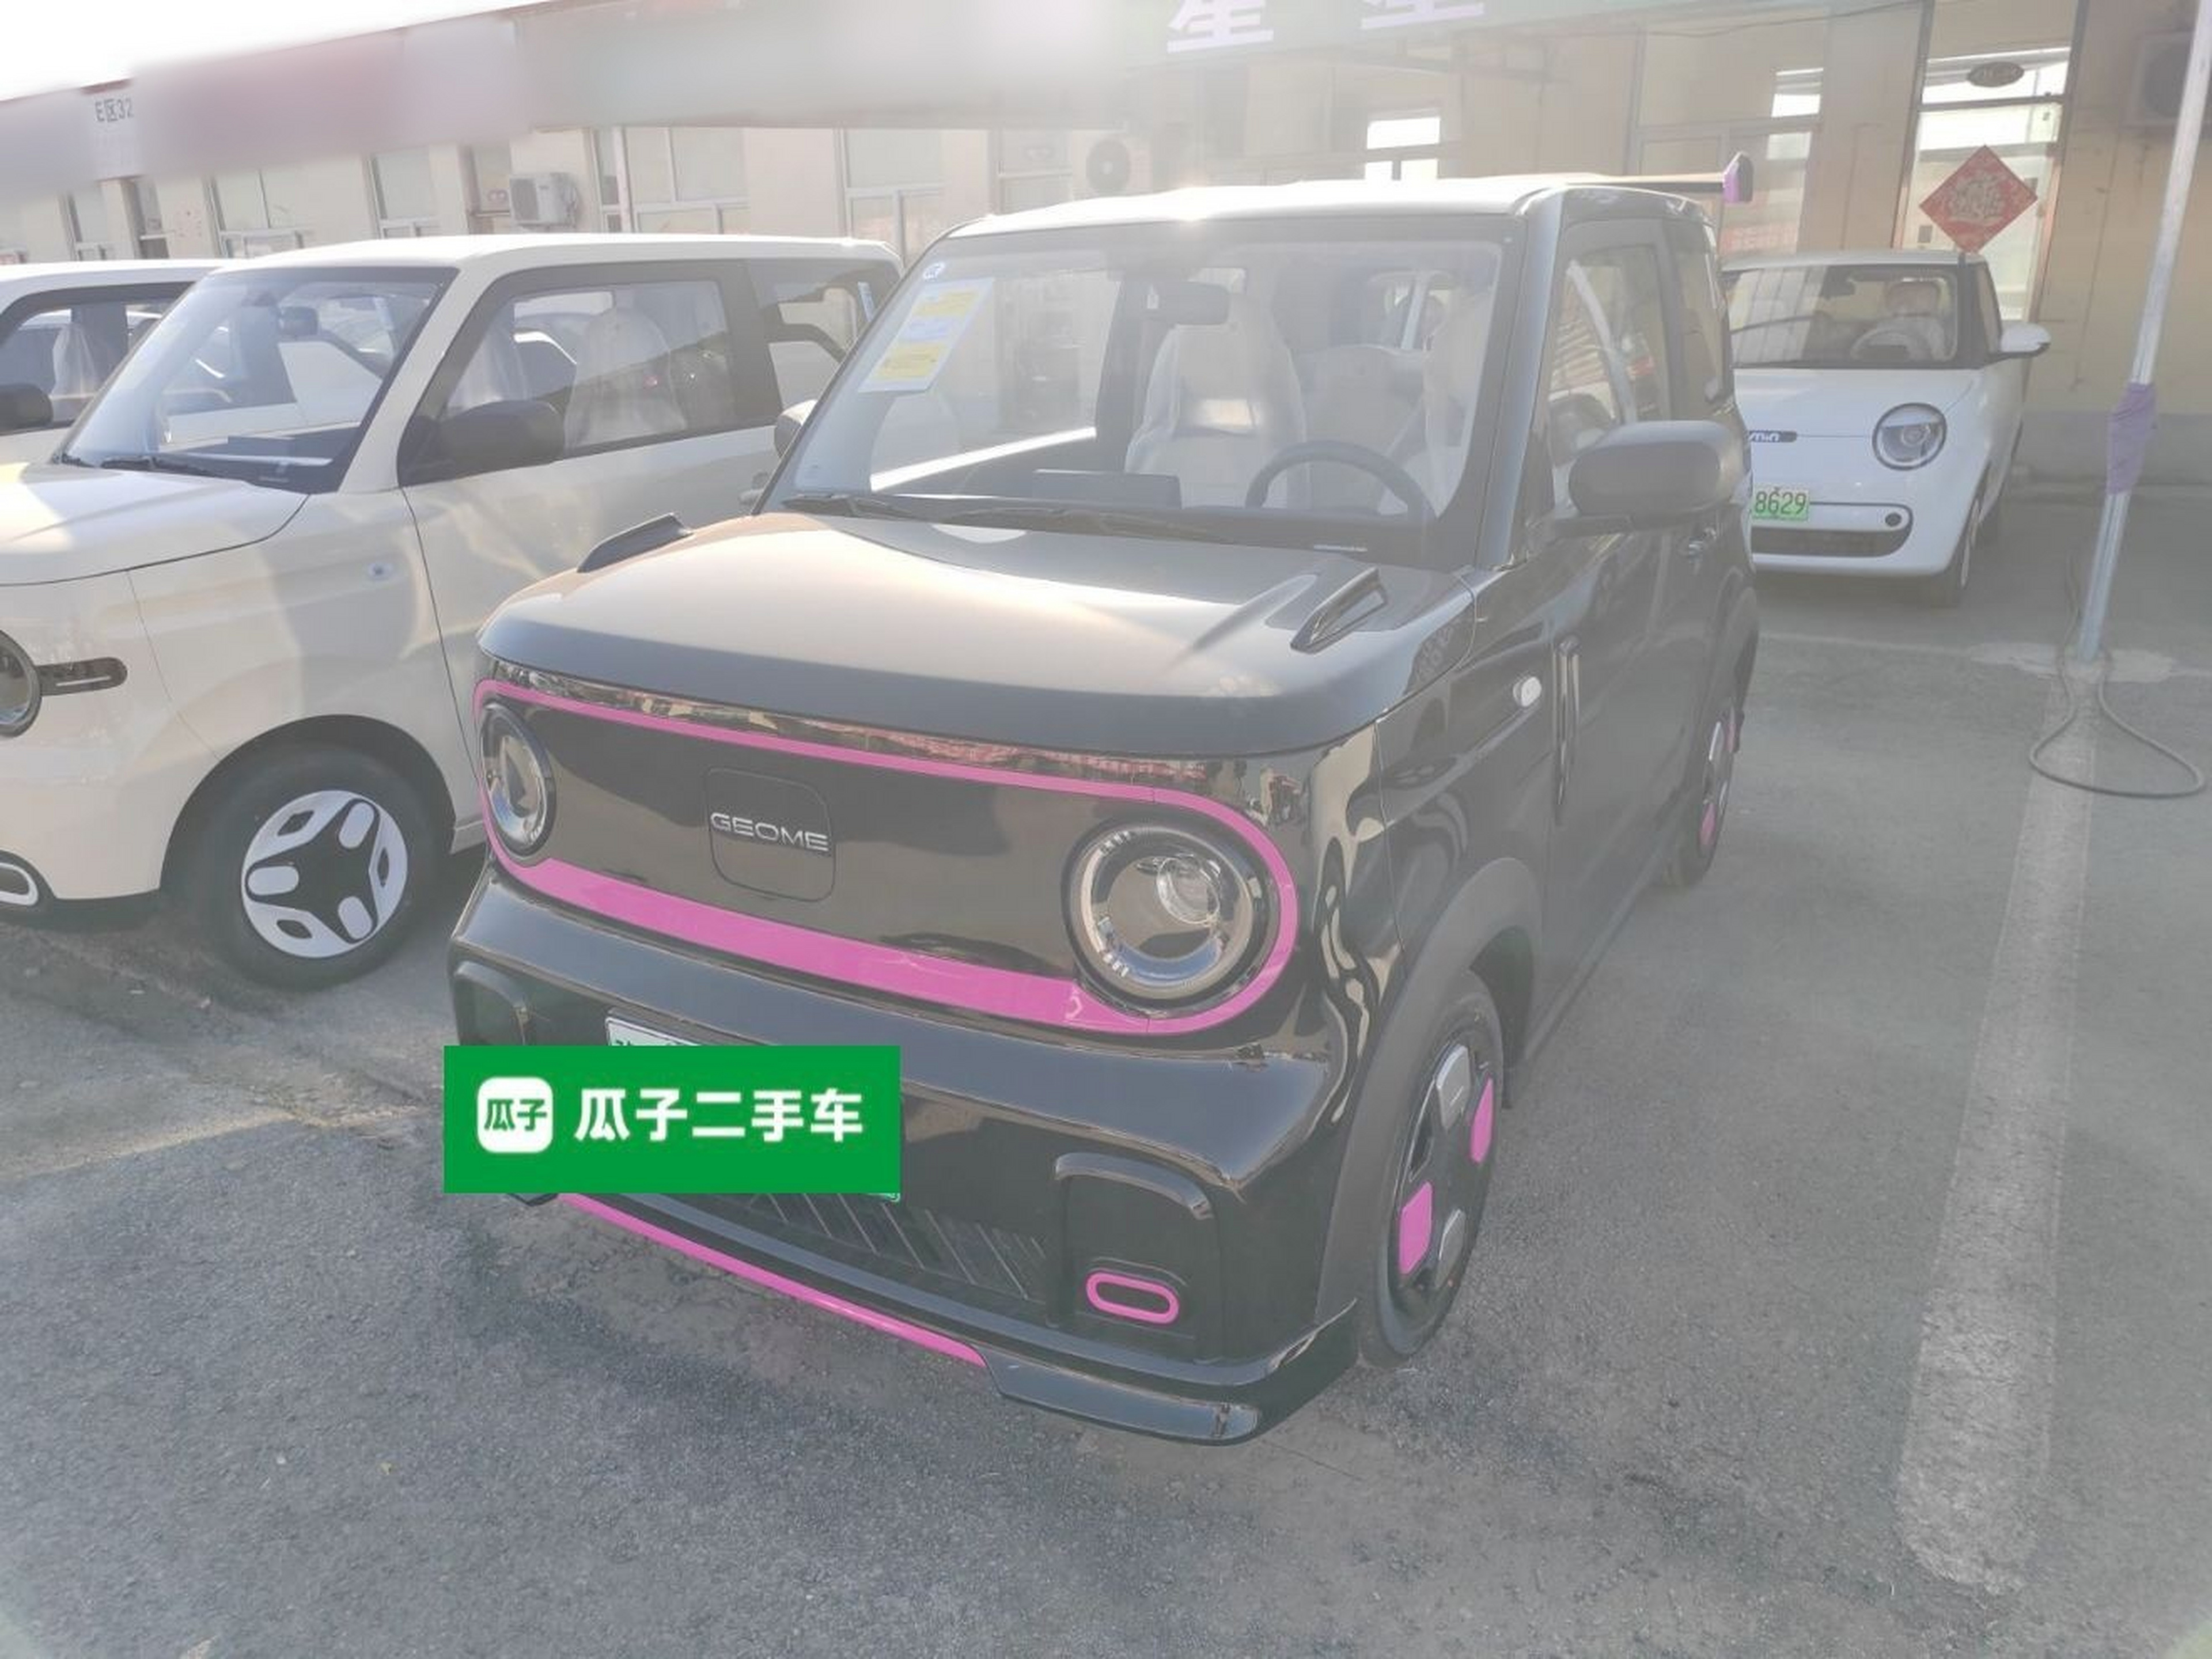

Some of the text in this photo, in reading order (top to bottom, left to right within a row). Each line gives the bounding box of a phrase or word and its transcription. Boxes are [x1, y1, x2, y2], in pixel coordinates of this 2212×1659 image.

[94, 98, 134, 122] E区32
[1755, 490, 1806, 514] 8629
[710, 812, 829, 851] GEOME
